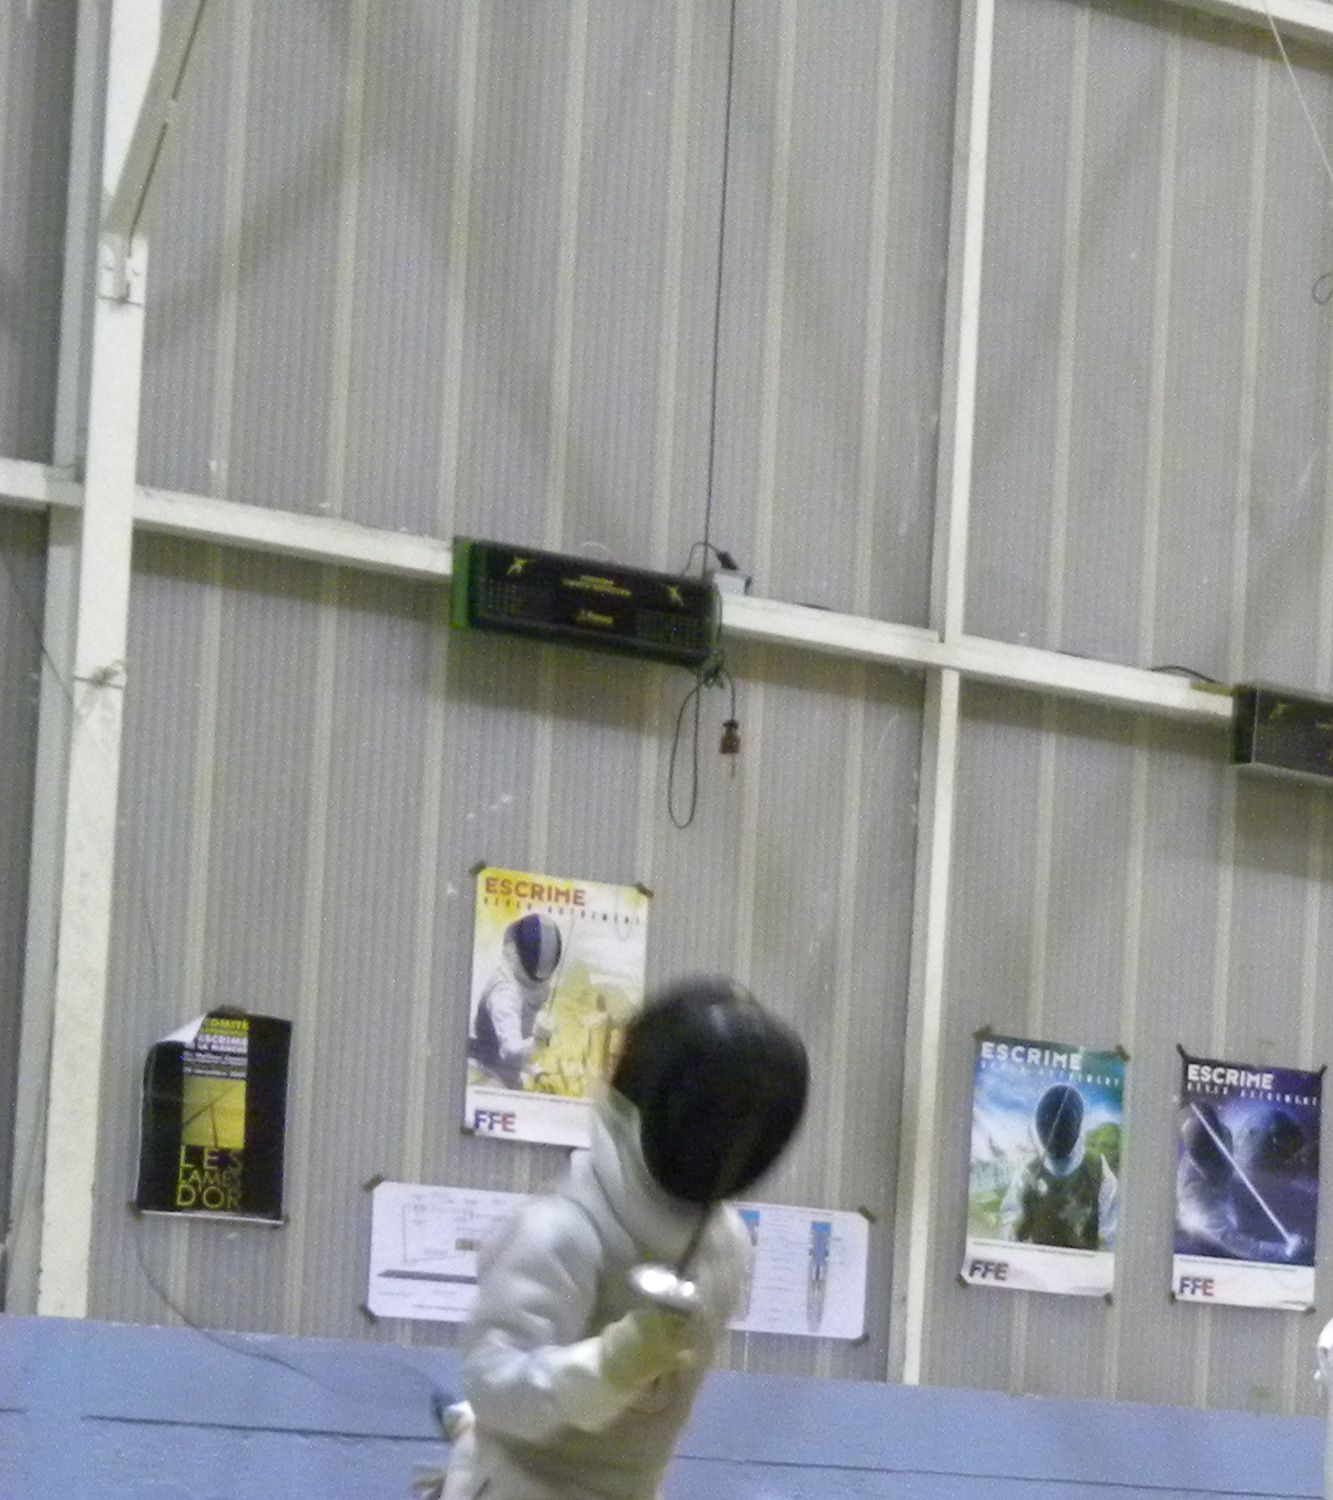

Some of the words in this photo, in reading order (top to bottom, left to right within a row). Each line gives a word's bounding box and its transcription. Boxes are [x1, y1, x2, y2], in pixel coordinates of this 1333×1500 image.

[485, 877, 586, 906] ESCRIME
[981, 1041, 1082, 1071] ESCRIME
[1187, 1064, 1274, 1090] ESCRIME
[474, 1109, 516, 1132] FFE
[180, 1144, 242, 1170] LES
[178, 1167, 242, 1187] LAMES
[176, 1183, 241, 1209] D'OR
[969, 1260, 1008, 1281] FFE
[1180, 1276, 1214, 1296] FFE
